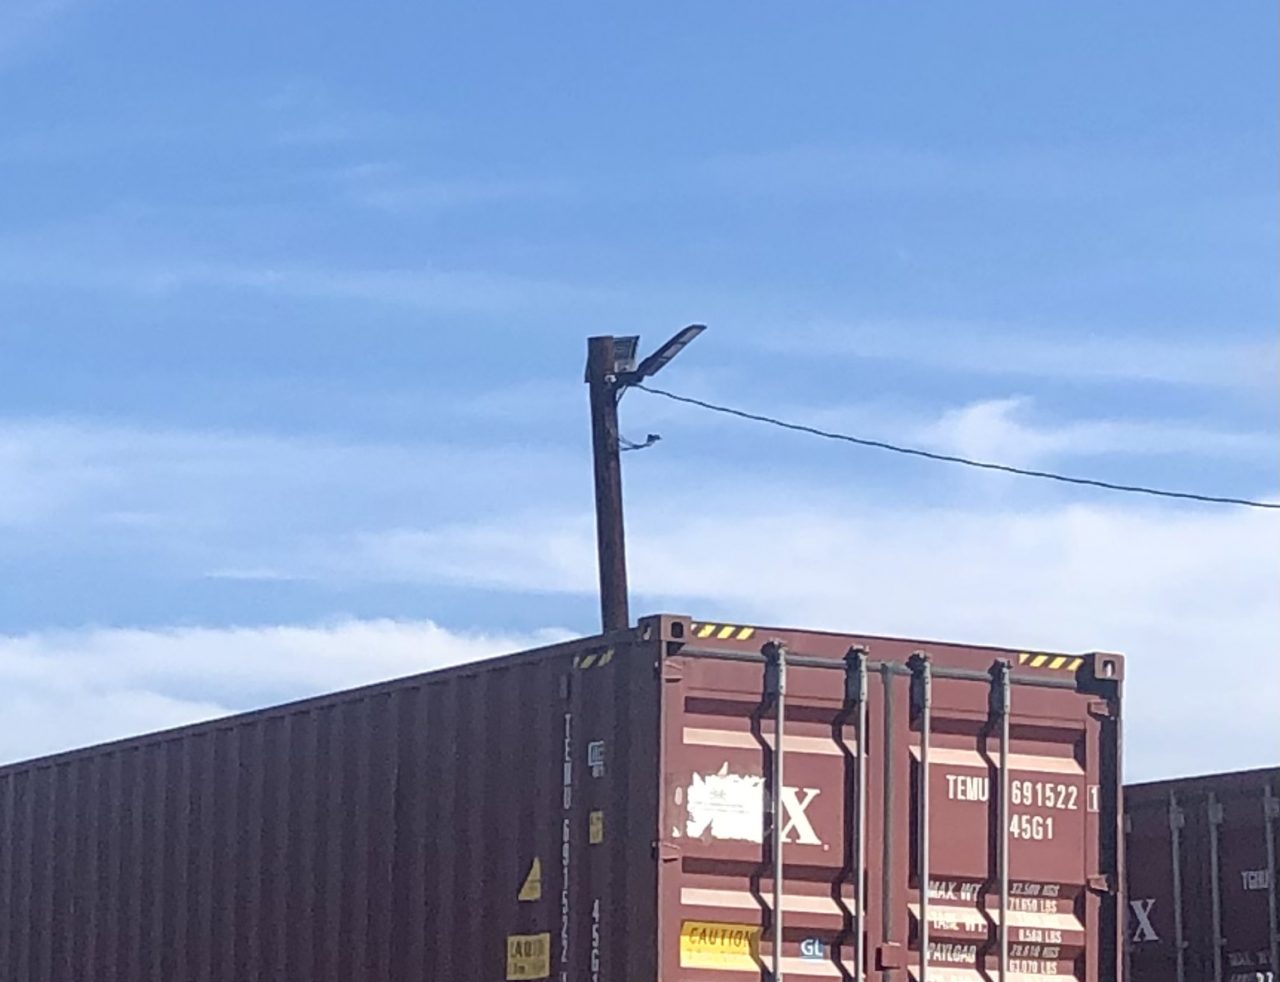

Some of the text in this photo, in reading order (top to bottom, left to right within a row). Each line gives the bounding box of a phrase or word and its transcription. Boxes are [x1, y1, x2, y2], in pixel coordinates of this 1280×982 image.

[946, 775, 1099, 811] TEMU 691522 1
[1009, 814, 1053, 840] 45G1
